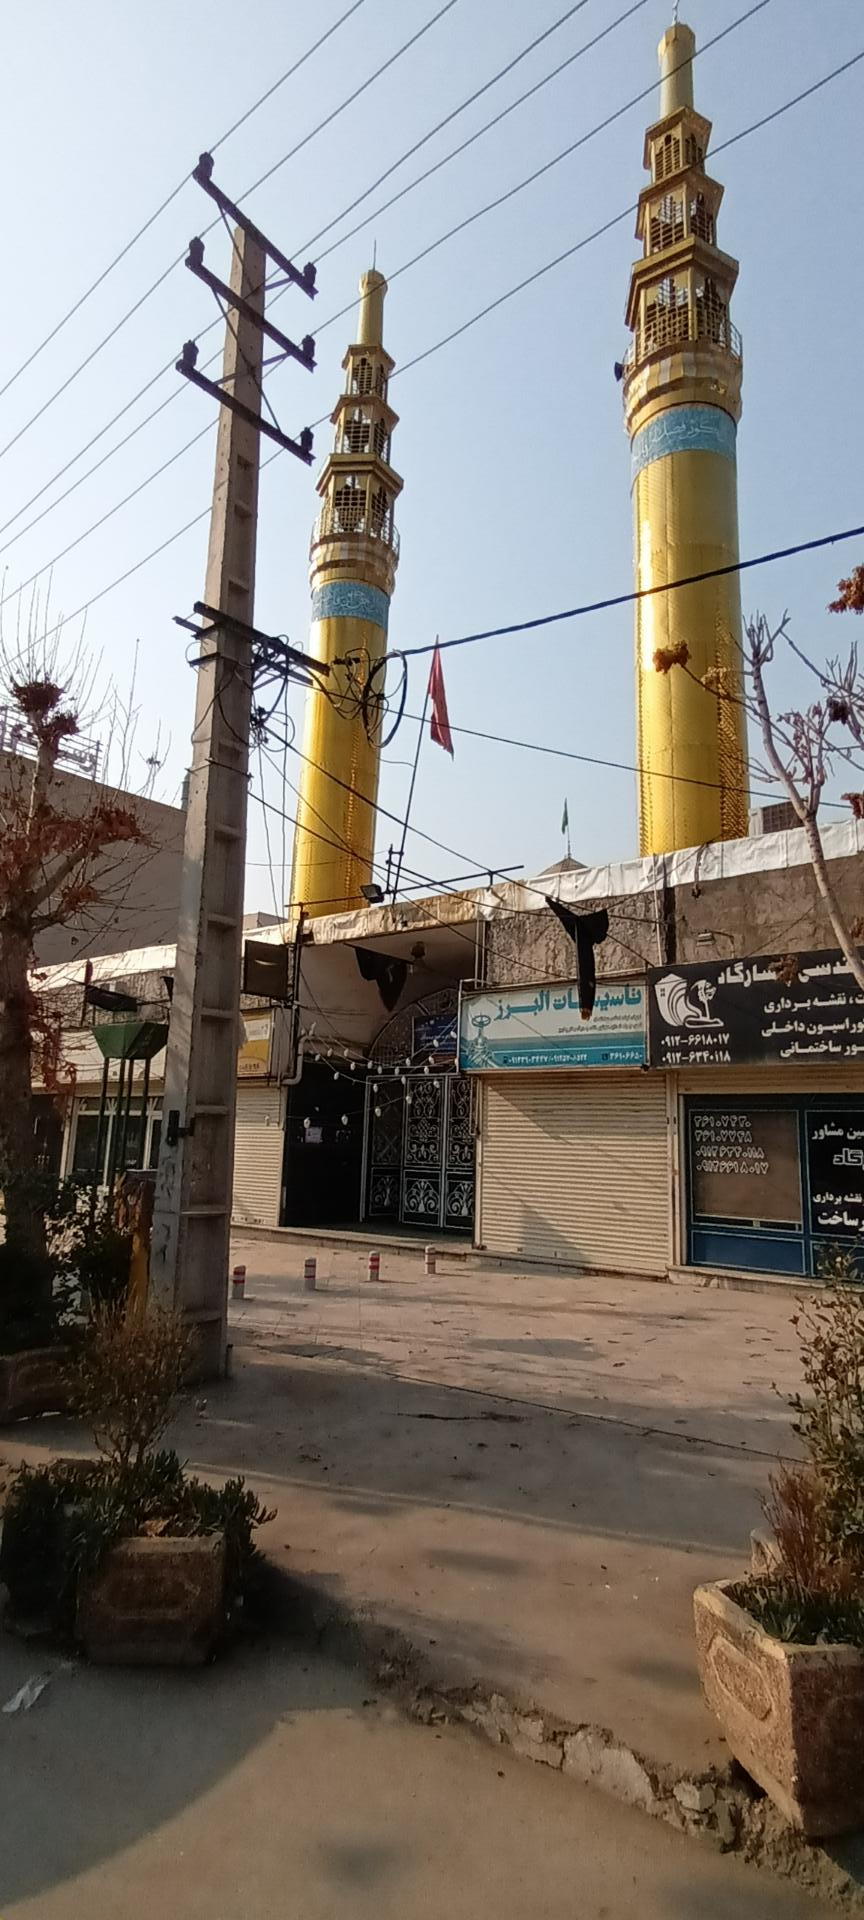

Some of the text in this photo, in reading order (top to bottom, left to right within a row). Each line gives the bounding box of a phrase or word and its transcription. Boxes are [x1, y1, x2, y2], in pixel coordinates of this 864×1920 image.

[494, 989, 550, 1021] البرز
[764, 998, 811, 1014] برداری
[813, 992, 847, 1007] نقشه
[761, 1020, 805, 1037] داخلی
[780, 1039, 841, 1057] ساختمانی
[811, 1122, 844, 1140] مشاور
[818, 1210, 859, 1227] ساخت
